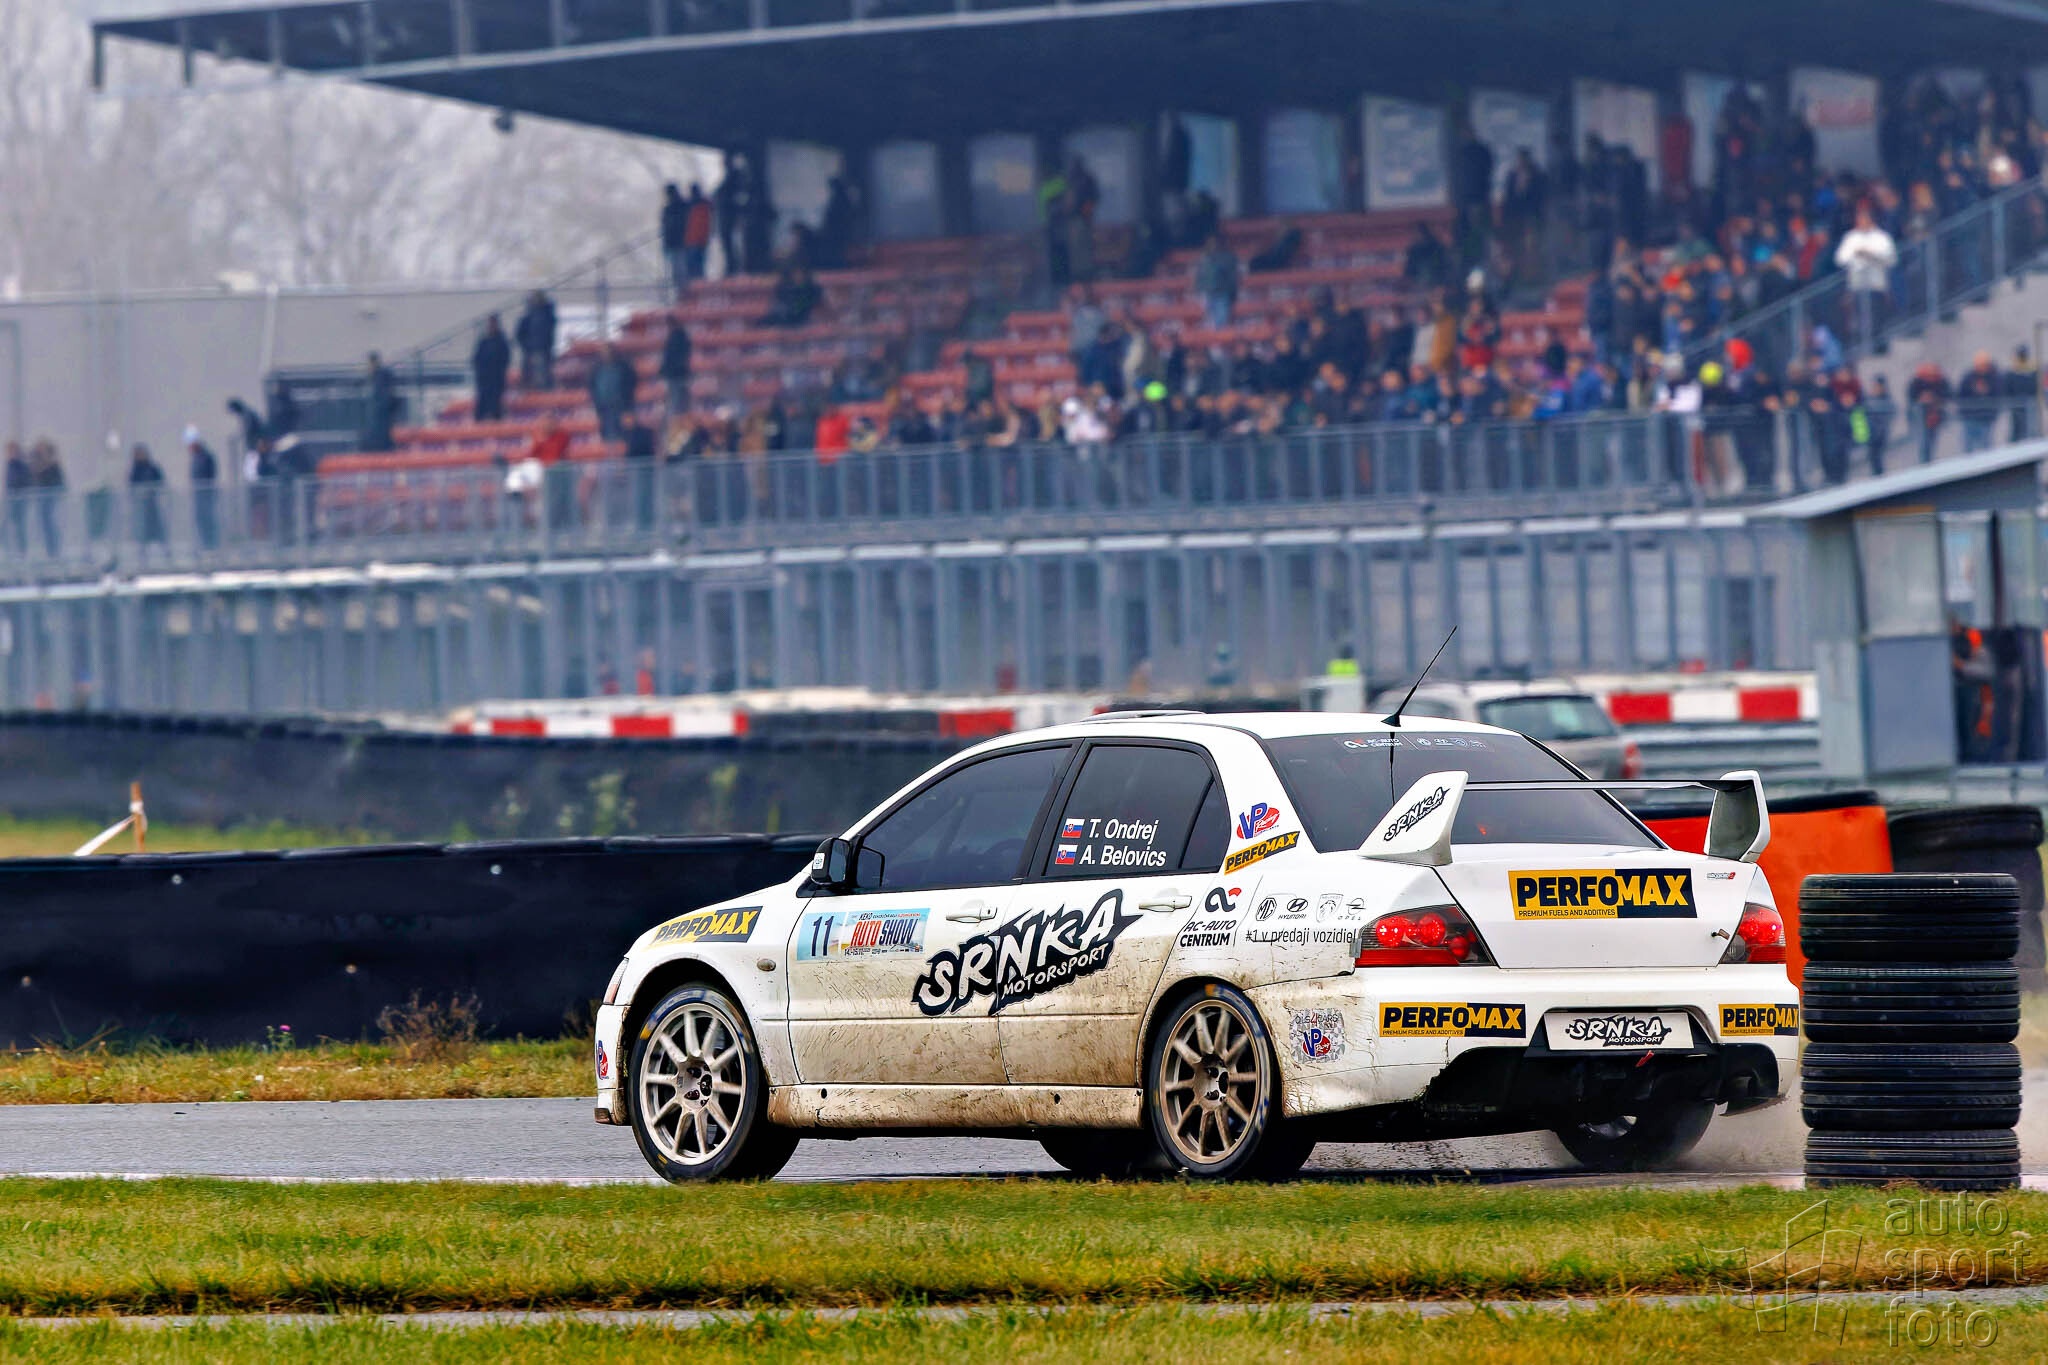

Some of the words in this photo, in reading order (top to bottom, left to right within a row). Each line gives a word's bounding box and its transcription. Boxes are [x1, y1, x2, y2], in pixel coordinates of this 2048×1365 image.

[1239, 802, 1267, 840] VP
[1384, 787, 1447, 841] SRNKA
[1089, 818, 1102, 838] T.
[1104, 818, 1159, 845] Ondrej
[1079, 844, 1096, 865] A.
[1100, 844, 1167, 867] Belovics
[1226, 833, 1298, 871] PERFOMAX
[1516, 874, 1689, 908] PERFOMAX
[653, 910, 759, 941] PERFOMAX
[811, 915, 835, 956] 11
[850, 920, 882, 947] AUTO
[879, 918, 919, 946] SHOW
[1180, 933, 1231, 947] CENTRUM
[1184, 920, 1237, 932] AC-AUTO
[1313, 929, 1357, 943] vozidiel
[917, 894, 1120, 1008] SRNKA
[1002, 943, 1109, 999] MOTORSPORT
[1383, 1006, 1523, 1030] PERFOMAX
[1568, 1017, 1663, 1040] SRNKA
[1723, 1007, 1799, 1028] PERFOMAX
[1303, 1028, 1322, 1057] VP
[1607, 1036, 1663, 1044] MOTORSPORT
